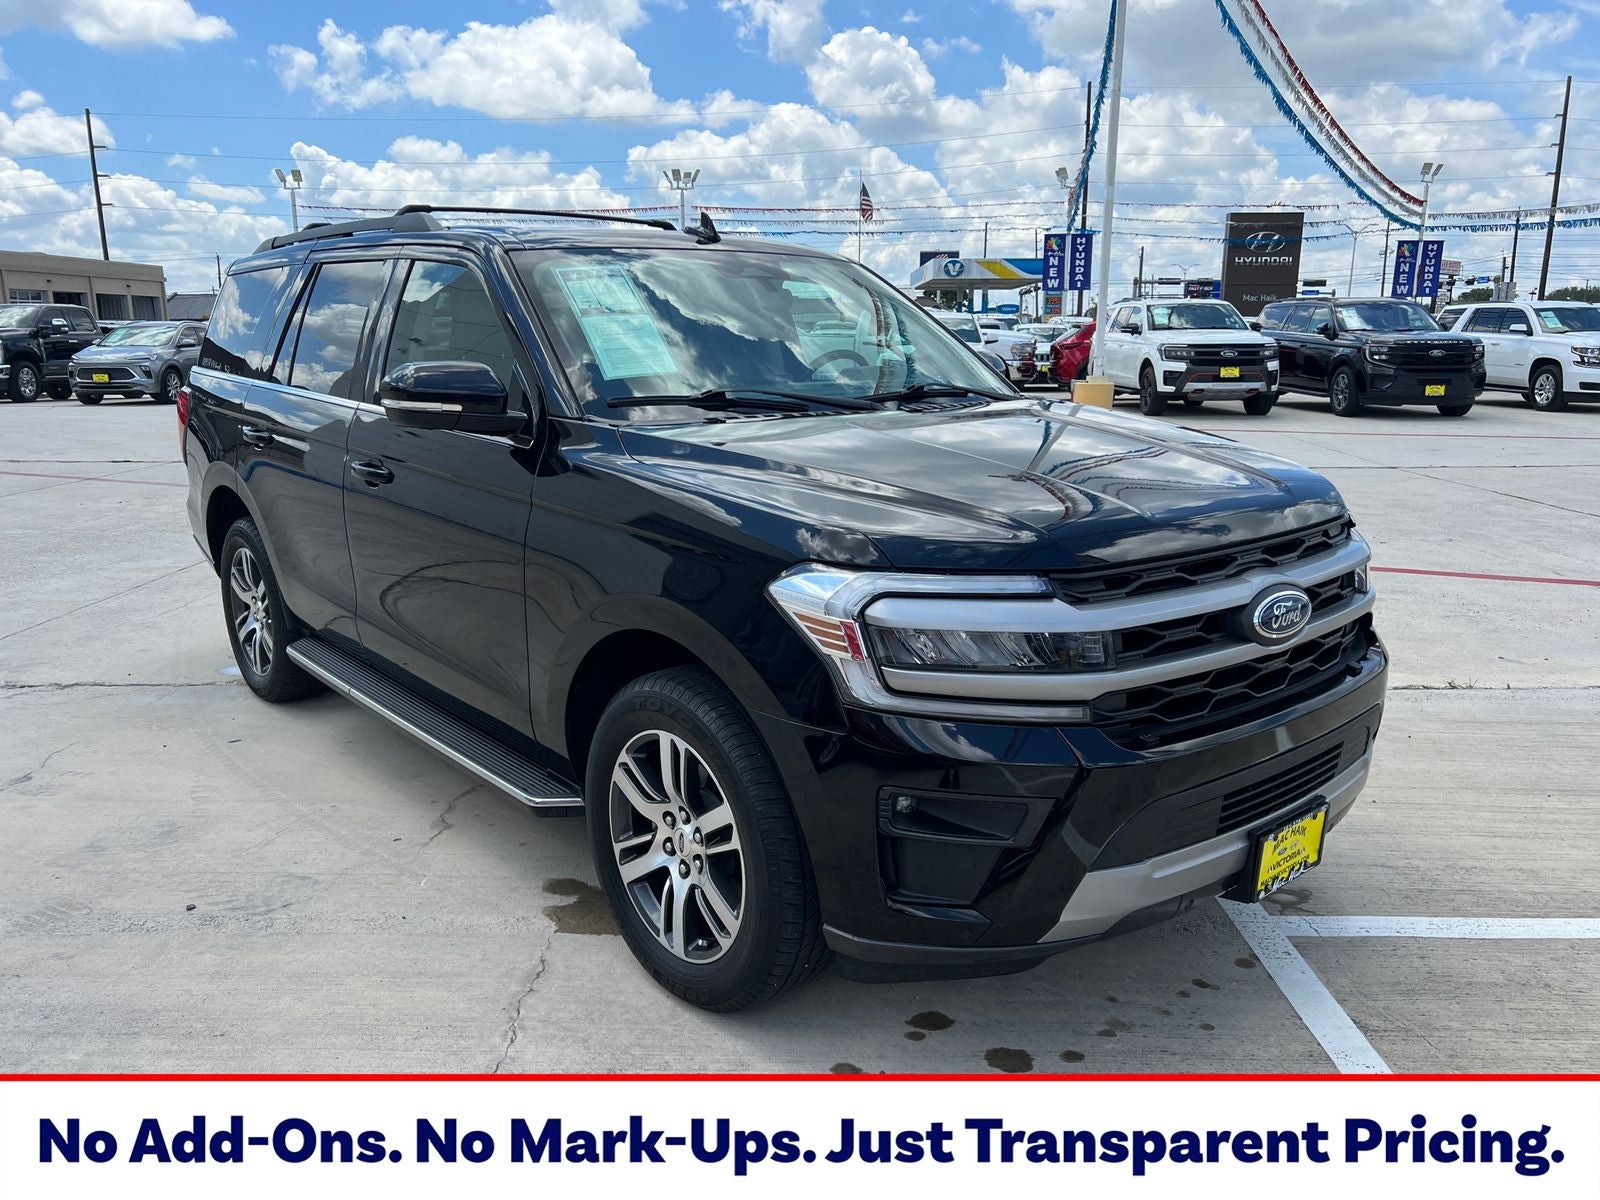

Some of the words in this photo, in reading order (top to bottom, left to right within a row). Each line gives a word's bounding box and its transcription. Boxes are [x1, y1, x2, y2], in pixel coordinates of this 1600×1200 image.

[1047, 257, 1060, 288] NEW
[1075, 237, 1086, 288] HYUNDAI
[1234, 256, 1293, 266] HYUNDAI
[1423, 244, 1438, 294] HYUNDAI
[1396, 263, 1409, 294] NEW
[1242, 294, 1258, 302] Mac
[1260, 293, 1277, 302] Haik
[1271, 600, 1302, 629] Ford
[1272, 828, 1289, 855] MAC
[1290, 824, 1308, 838] HAIK
[1271, 850, 1301, 872] VICTORIA
